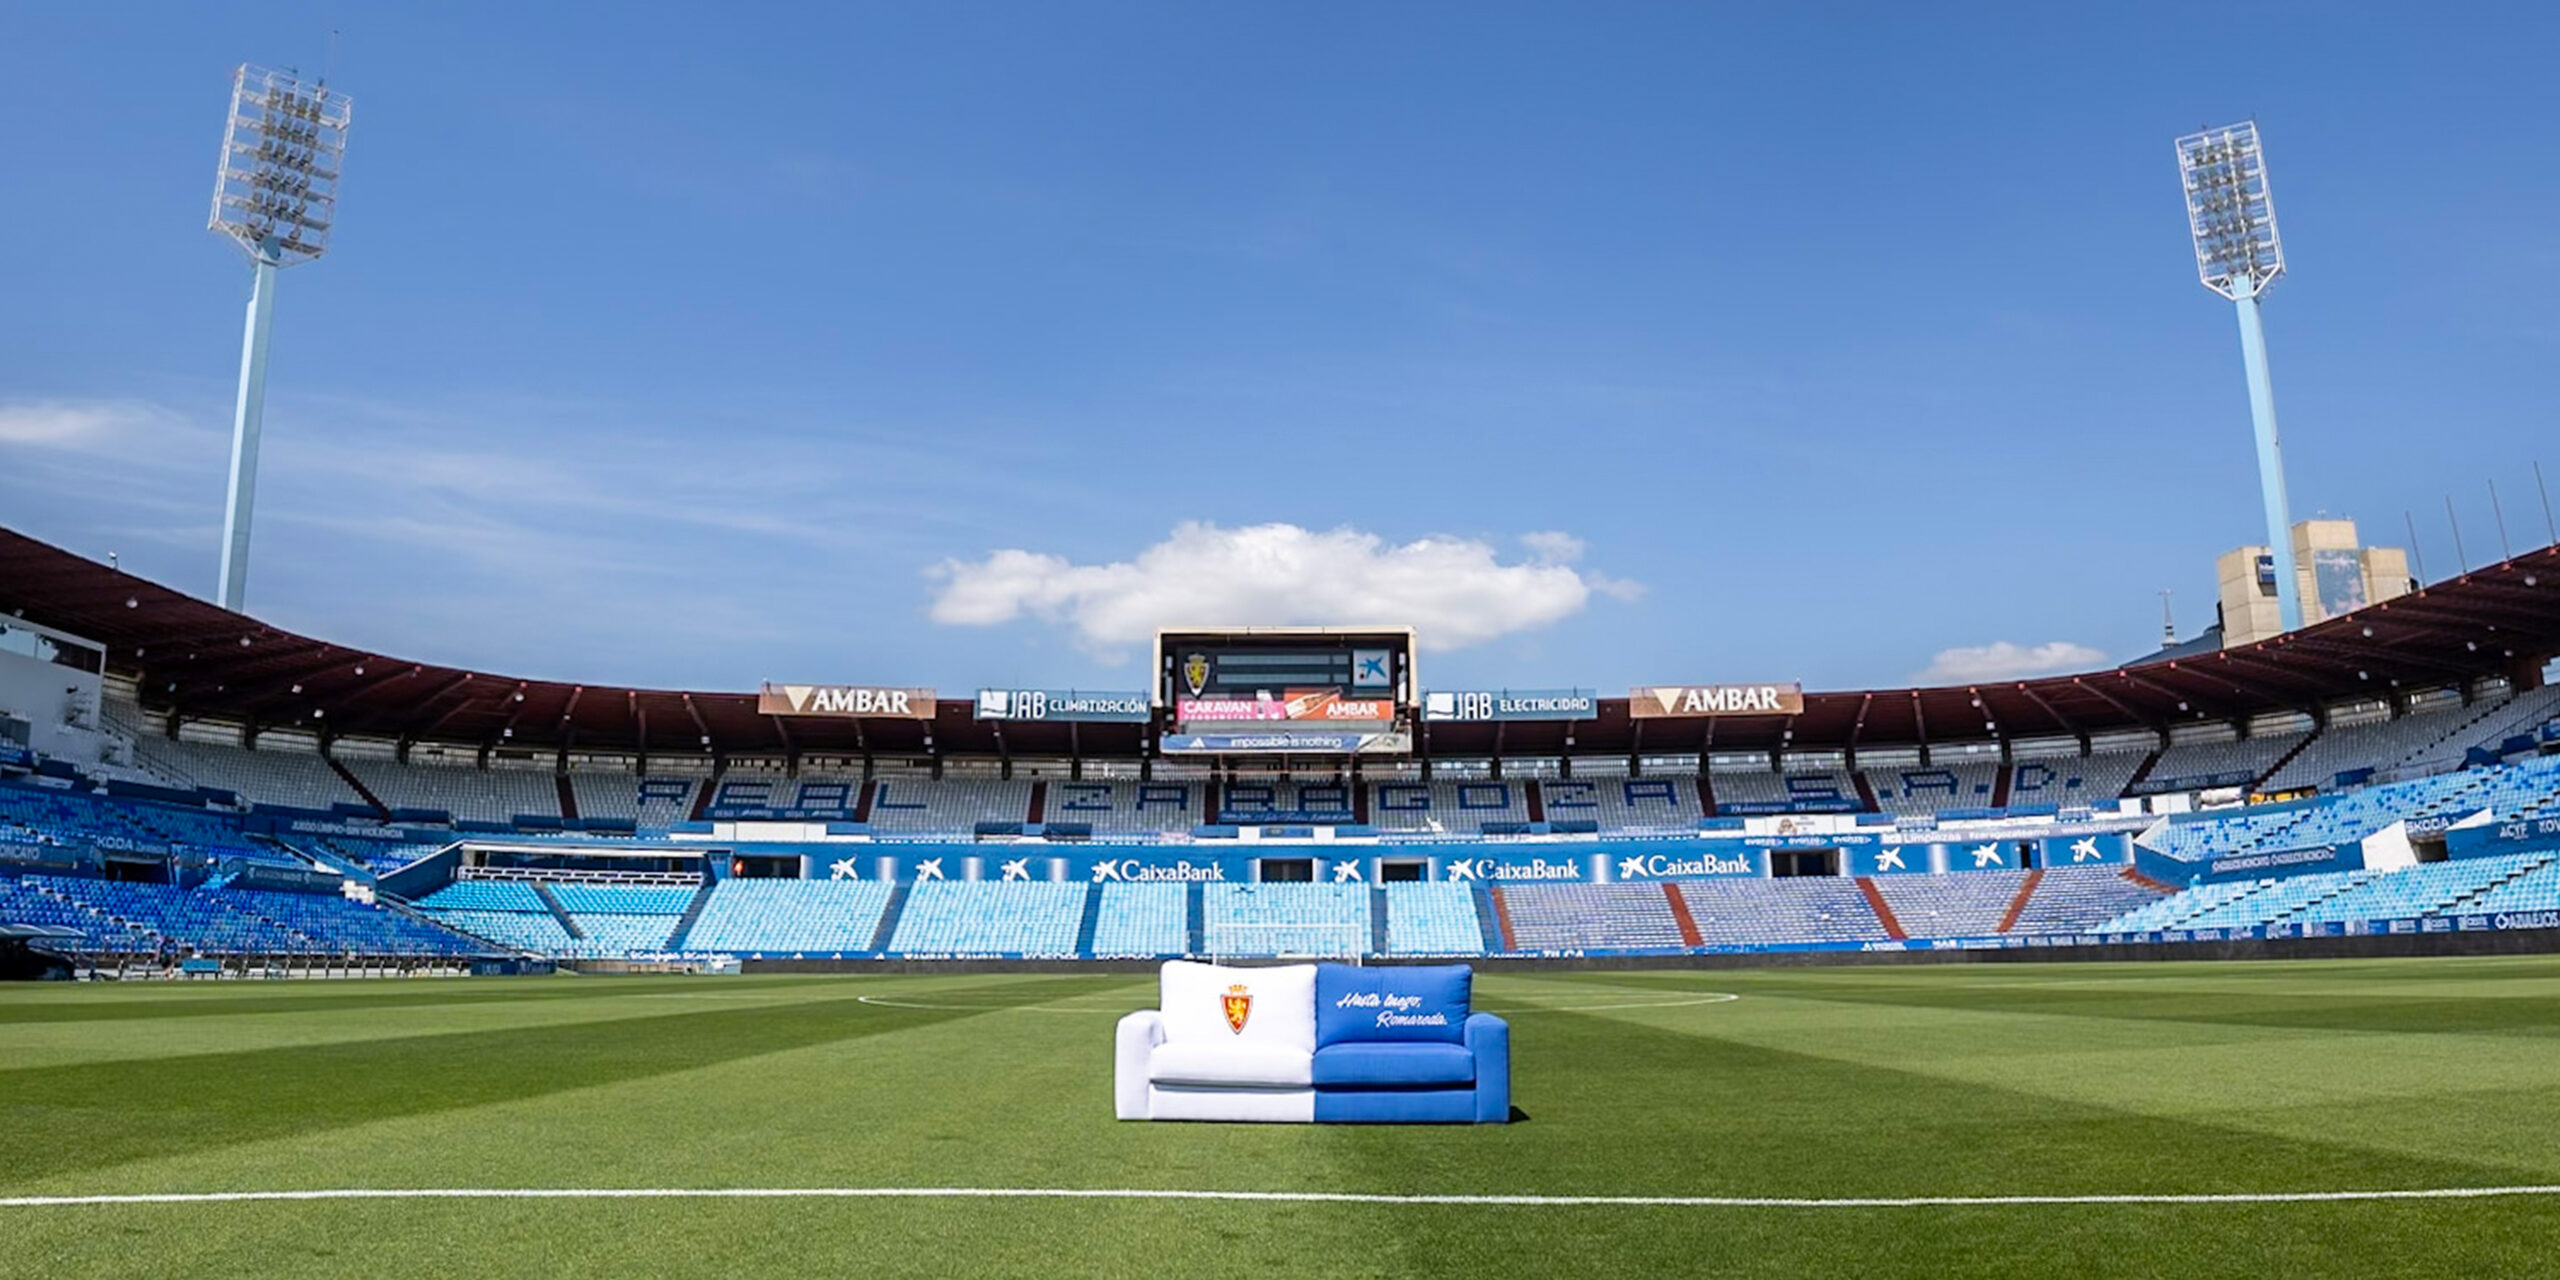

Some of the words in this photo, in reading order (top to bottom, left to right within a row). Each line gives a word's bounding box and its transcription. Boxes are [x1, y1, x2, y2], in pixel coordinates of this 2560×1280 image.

[811, 689, 911, 714] AMBAR
[1008, 691, 1046, 719] JAB
[1050, 698, 1147, 713] CLIMATIZACIÓN
[1184, 700, 1251, 714] CARAVAN
[1326, 701, 1379, 716] AMBAR
[1456, 692, 1492, 719] JAB
[1500, 697, 1589, 712] ELECTRICIDAD
[1683, 687, 1782, 713] AMBAR
[1231, 736, 1289, 749] impossible
[1291, 738, 1300, 748] is
[1301, 737, 1342, 749] nothing
[96, 836, 134, 850] KODA
[1120, 859, 1226, 882] CaixaBank
[1475, 858, 1580, 880] CaixaBank
[1648, 853, 1752, 877] CaixaBank
[1336, 992, 1380, 1009] Hasta
[1383, 992, 1422, 1012] luego,
[1376, 1010, 1448, 1028] Romareda.
